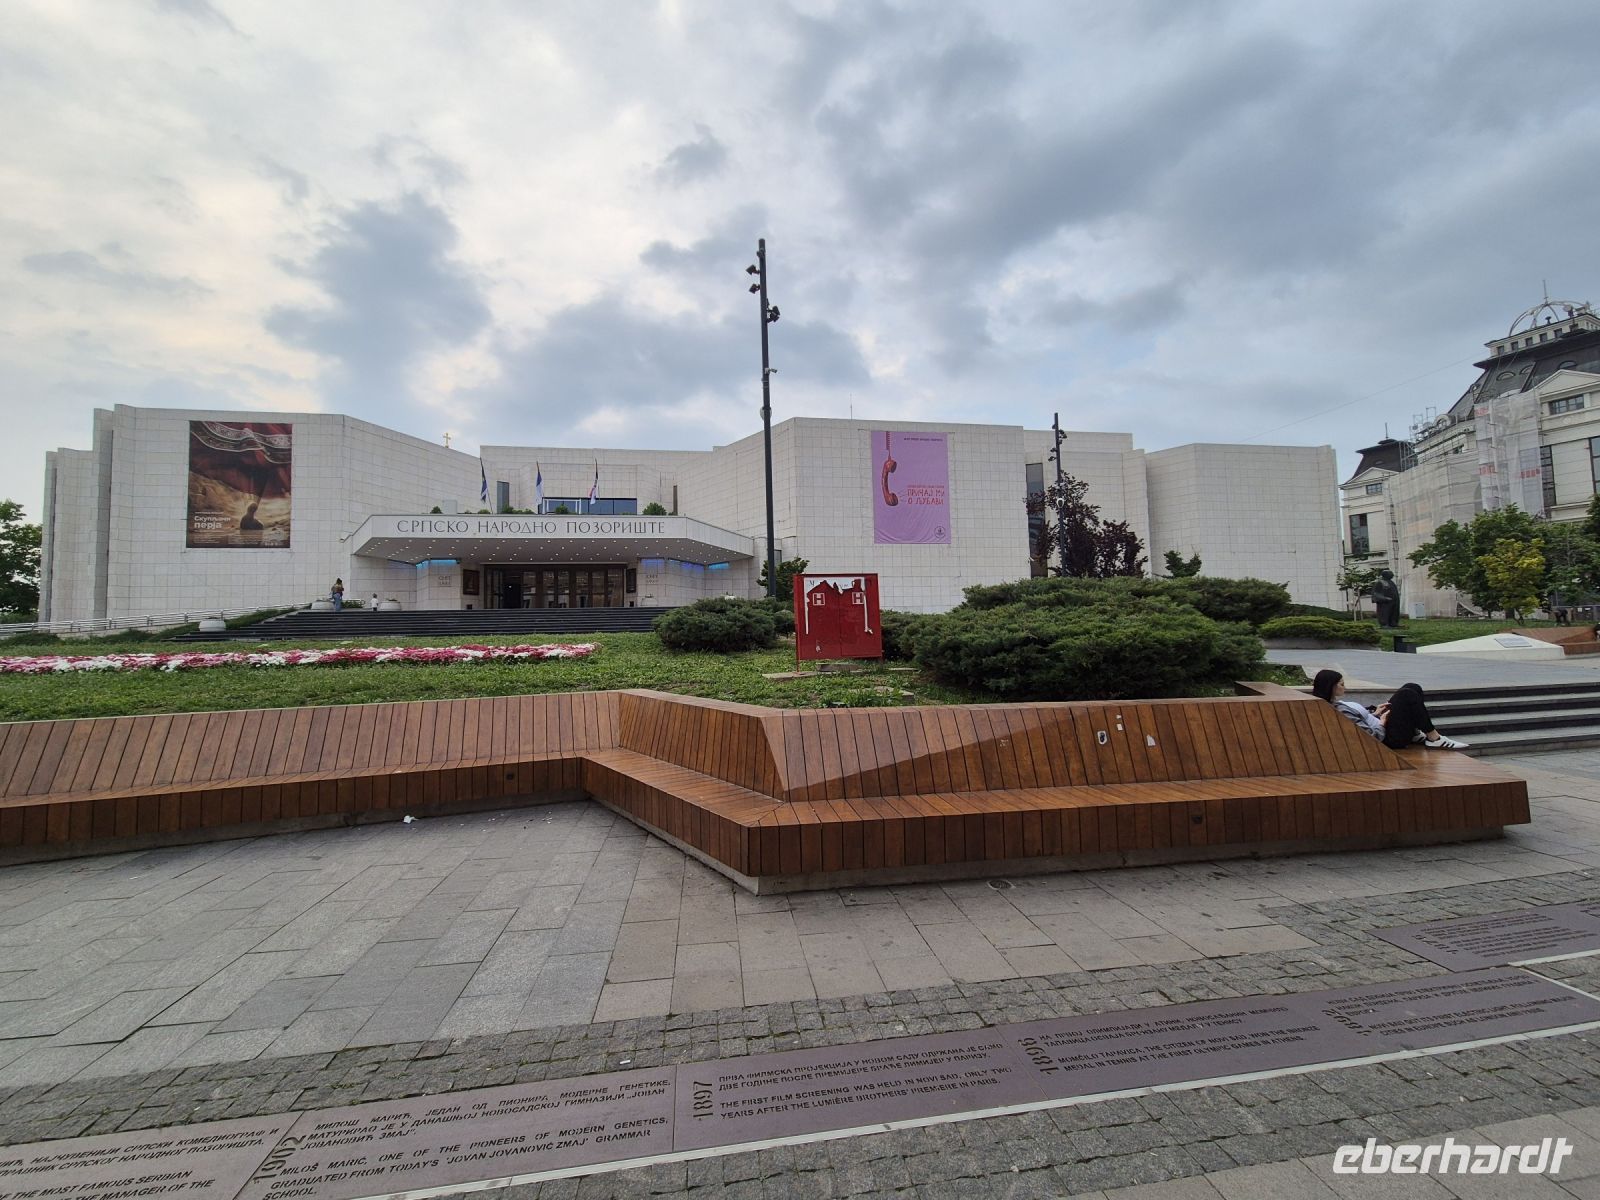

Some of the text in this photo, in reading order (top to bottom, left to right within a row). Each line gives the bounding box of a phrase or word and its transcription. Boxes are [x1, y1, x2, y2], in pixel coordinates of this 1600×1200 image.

[396, 520, 665, 534] СРПСКО НАРОДНО ПОЗОРИШТЕ
[719, 1074, 744, 1082] ПРВА
[746, 1068, 792, 1080] ФИЛМСКА
[794, 1061, 853, 1074] ПРОЈЕКЦИЈА
[862, 1056, 895, 1064] НОВОМ
[922, 1048, 966, 1058] ОДРЖАНА
[1018, 1038, 1059, 1074] 1896
[1064, 1062, 1095, 1072] MEDAL
[1106, 1056, 1138, 1066] TENNIS
[1169, 1050, 1194, 1058] FIRST
[718, 1082, 738, 1091] ДВЕ
[742, 1078, 778, 1088] ГОДИНЕ
[781, 1074, 813, 1082] ПОСЛЕ
[814, 1066, 869, 1079] ПРЕМИЈЕРЕ
[870, 1063, 903, 1072] БРАЋЕ
[904, 1058, 945, 1067] ЛИМИЈЕР
[720, 1100, 739, 1108] THE
[742, 1096, 768, 1106] FIRST
[772, 1094, 793, 1102] FILM
[795, 1086, 850, 1099] SCREENING
[854, 1083, 875, 1092] WAS
[876, 1080, 902, 1088] HELD
[916, 1076, 938, 1084] NOVI
[964, 1069, 988, 1078] ONLY
[315, 1119, 360, 1130] МИЛОШ
[425, 1106, 461, 1116] ЈЕДАН
[498, 1095, 549, 1106] ПИОНИРА
[560, 1088, 608, 1099] МОДЕРНЕ
[692, 1081, 713, 1121] 1897
[720, 1110, 754, 1120] YEARS
[756, 1104, 788, 1114] AFTER
[790, 1100, 810, 1109] THE
[970, 1078, 1000, 1086] PARIS.
[307, 1125, 378, 1141] МАТУРИРАО
[381, 1122, 396, 1131] ЈЕ
[400, 1121, 408, 1129] У
[411, 1112, 478, 1128] ДАНАШЊОЈ
[482, 1102, 560, 1116] НОВОСАДСКОЈ
[564, 1094, 625, 1106] ГИМНАЗИЈИ
[124, 1141, 174, 1153] СРПСКИ
[176, 1130, 265, 1146] КОМЕДИОГРАФ
[268, 1128, 280, 1136] И
[280, 1162, 319, 1176] MILOŠ
[378, 1152, 404, 1162] ONE
[412, 1148, 430, 1157] OF
[440, 1144, 461, 1154] THE
[470, 1136, 526, 1150] PIONEERS
[534, 1132, 550, 1140] OF
[558, 1125, 605, 1137] MODERN
[300, 1134, 374, 1150] ЈОВАНОВИЋ
[58, 1157, 120, 1170] СРПСКОГ
[118, 1148, 186, 1162] НАРОДНОГ
[252, 1134, 308, 1184] 1902
[270, 1172, 348, 1190] GRADUATED
[350, 1166, 384, 1178] FROM
[489, 1142, 554, 1158] JOVANOVIĆ
[596, 1130, 651, 1143] GRAMMAR
[12, 1190, 40, 1199] THE
[38, 1184, 80, 1196] MOST
[78, 1178, 135, 1192] FAMOUS
[136, 1170, 192, 1184] SERBIAN
[100, 1184, 167, 1200] MANAGER
[168, 1182, 188, 1192] OF
[190, 1178, 216, 1189] THE
[262, 1187, 318, 1200] SCHOOL.
